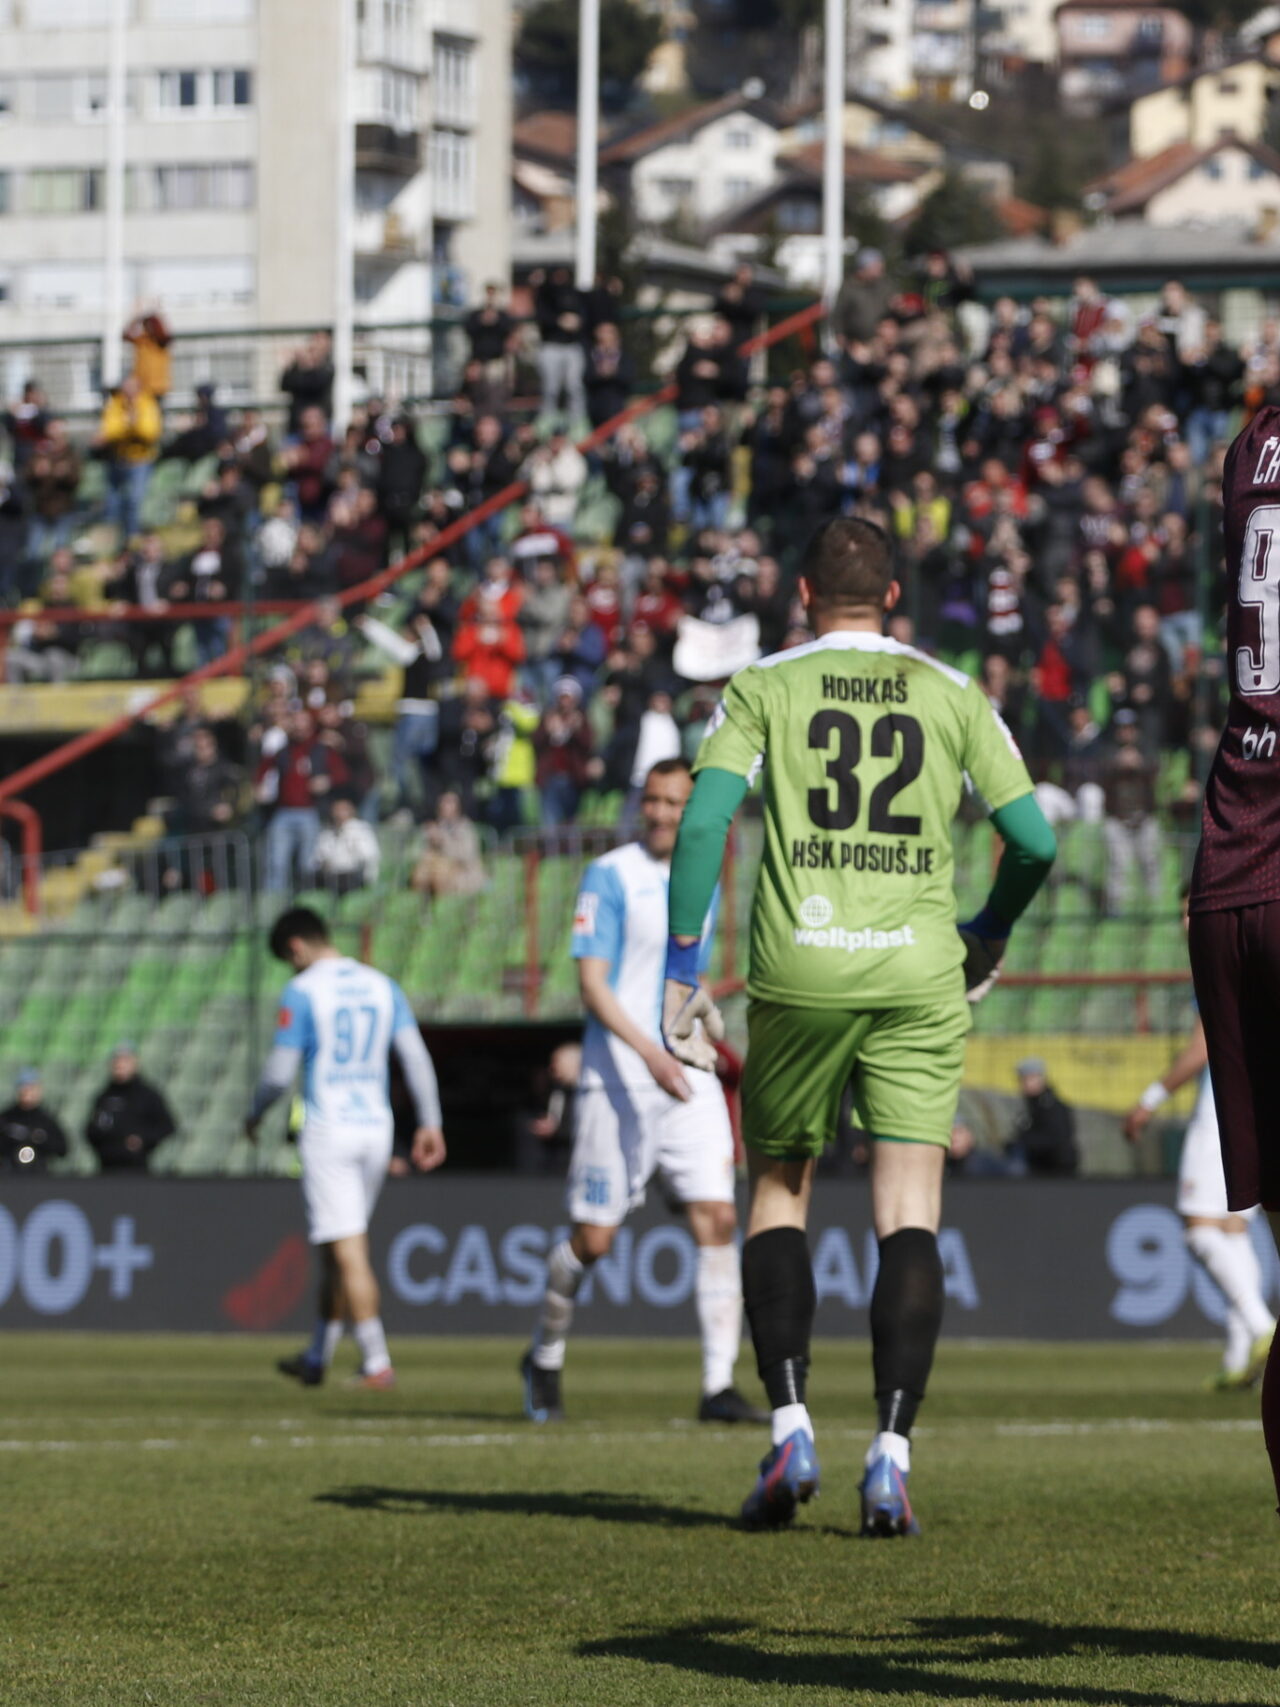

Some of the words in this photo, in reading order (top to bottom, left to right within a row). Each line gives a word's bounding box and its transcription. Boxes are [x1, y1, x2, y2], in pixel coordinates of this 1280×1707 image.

[822, 673, 908, 704] HORKAŠ
[807, 709, 925, 836] 32
[792, 835, 834, 869] HŠK
[840, 840, 934, 876] POSUŠJE
[794, 924, 918, 954] weltplast
[333, 1006, 378, 1065] 97
[0, 1198, 155, 1317] 0+
